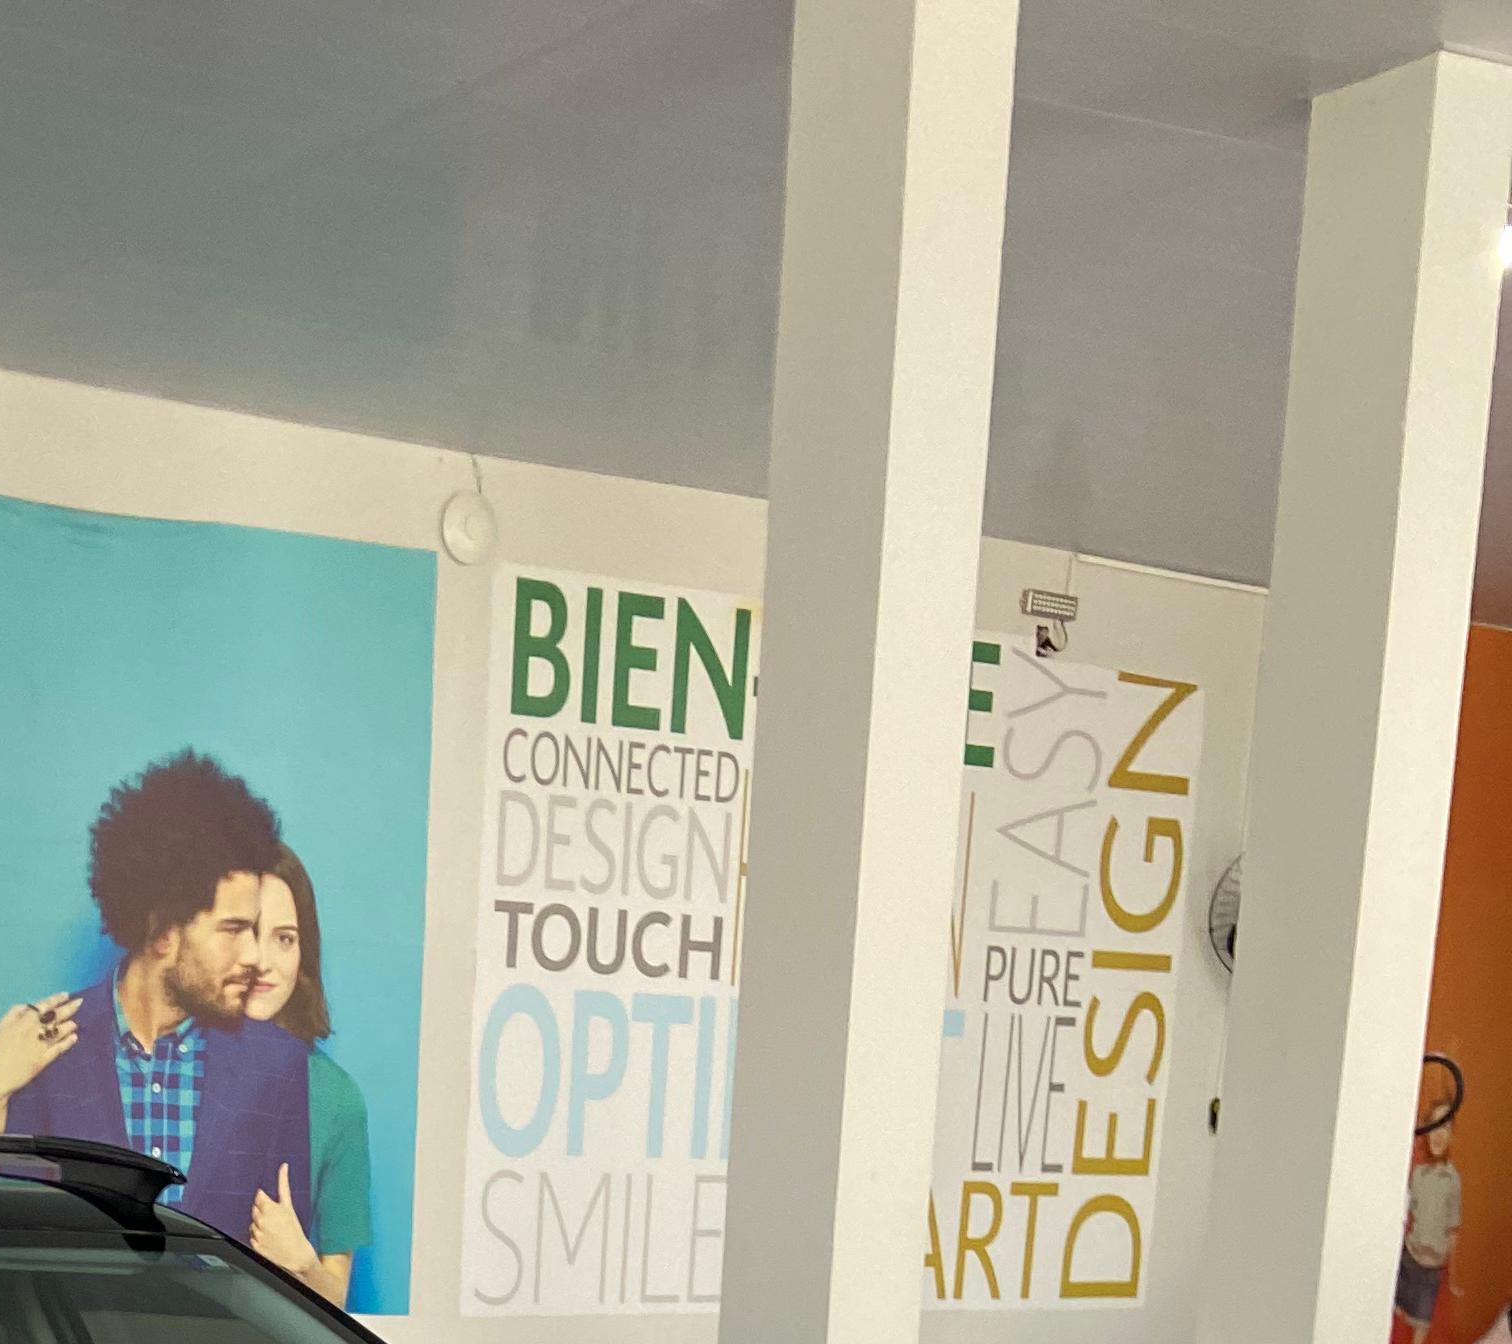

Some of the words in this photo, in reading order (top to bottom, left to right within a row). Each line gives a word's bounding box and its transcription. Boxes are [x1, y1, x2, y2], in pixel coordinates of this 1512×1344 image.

[503, 727, 741, 803] CONNECTED
[989, 647, 1108, 938] EASY
[495, 789, 733, 904] DESIGN
[494, 899, 724, 980] TOUCH
[983, 945, 1085, 1007] PURE
[1059, 670, 1198, 1299] DESIGN
[478, 983, 738, 1160] OPTI
[972, 1012, 1077, 1173] LIVE
[474, 1169, 728, 1306] SMILE
